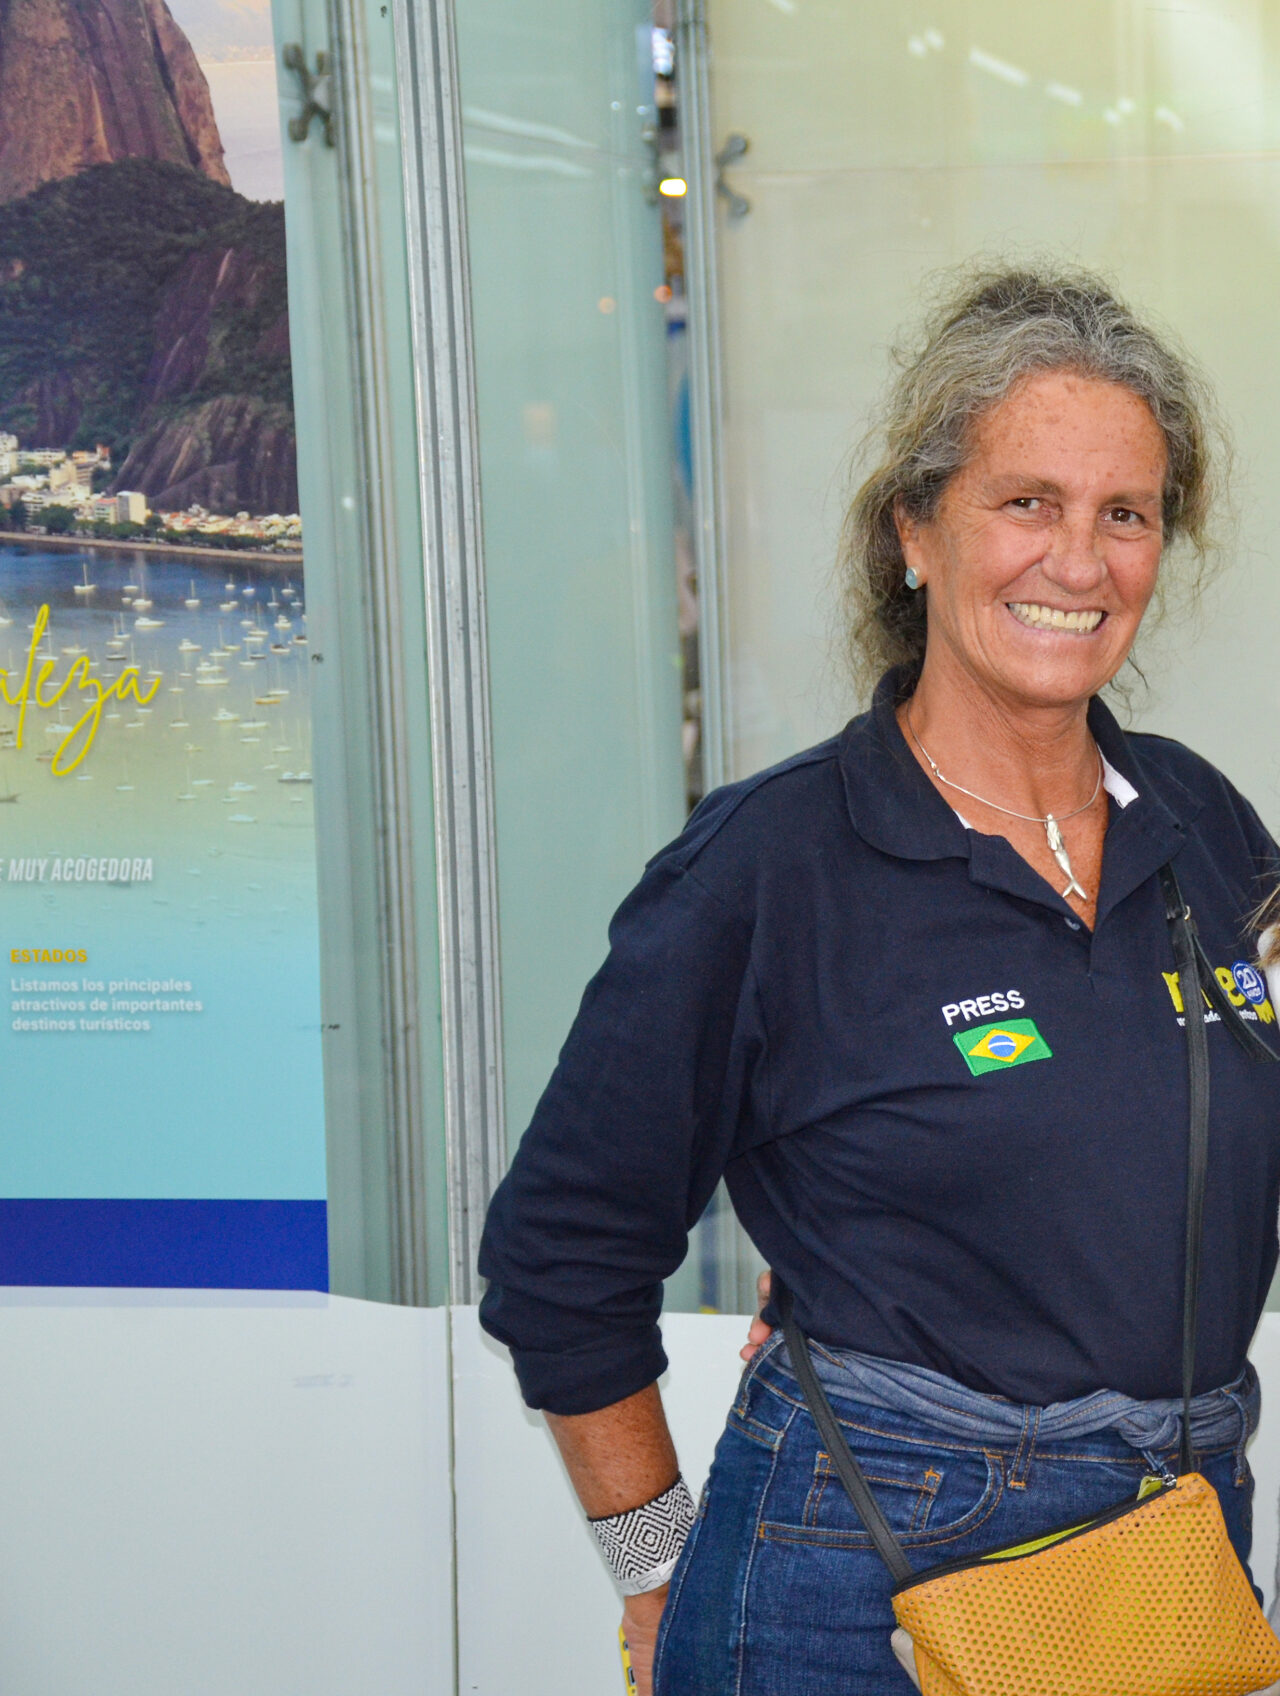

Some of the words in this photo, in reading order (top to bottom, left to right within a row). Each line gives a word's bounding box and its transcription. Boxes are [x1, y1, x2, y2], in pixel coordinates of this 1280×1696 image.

[8, 858, 48, 881] MUY
[51, 858, 153, 881] ACOGEDORA
[10, 949, 88, 963] ESTADOS
[1235, 967, 1258, 990] 20
[11, 979, 79, 992] Listamos
[83, 979, 105, 992] los
[109, 979, 192, 995] principales
[11, 998, 86, 1012] atractivos
[90, 998, 108, 1012] de
[112, 998, 203, 1014] importantes
[941, 990, 1025, 1026] PRESS
[12, 1018, 76, 1031] destinos
